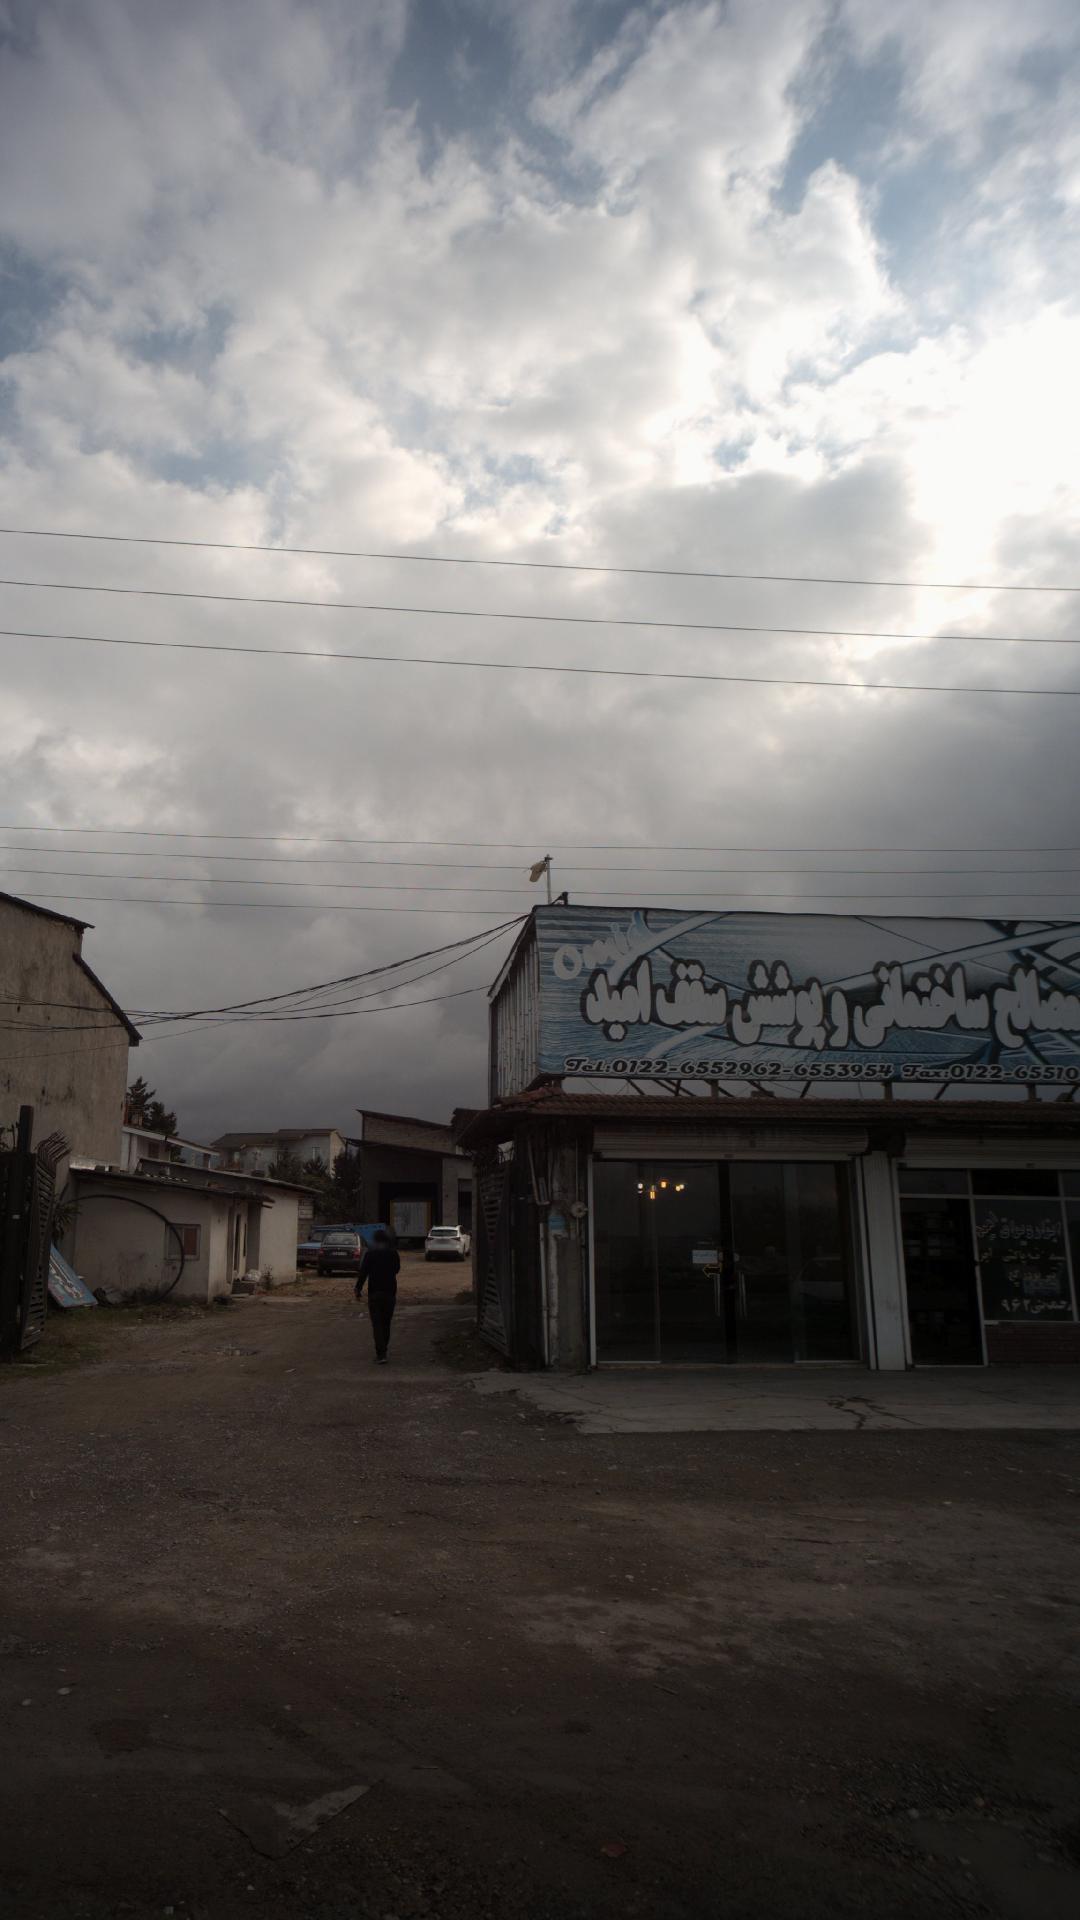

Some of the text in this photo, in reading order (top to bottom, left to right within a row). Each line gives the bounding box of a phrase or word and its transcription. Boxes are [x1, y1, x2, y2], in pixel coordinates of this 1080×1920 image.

[585, 958, 1080, 1050] مصالح ساختمانی و پوشش سقف امید
